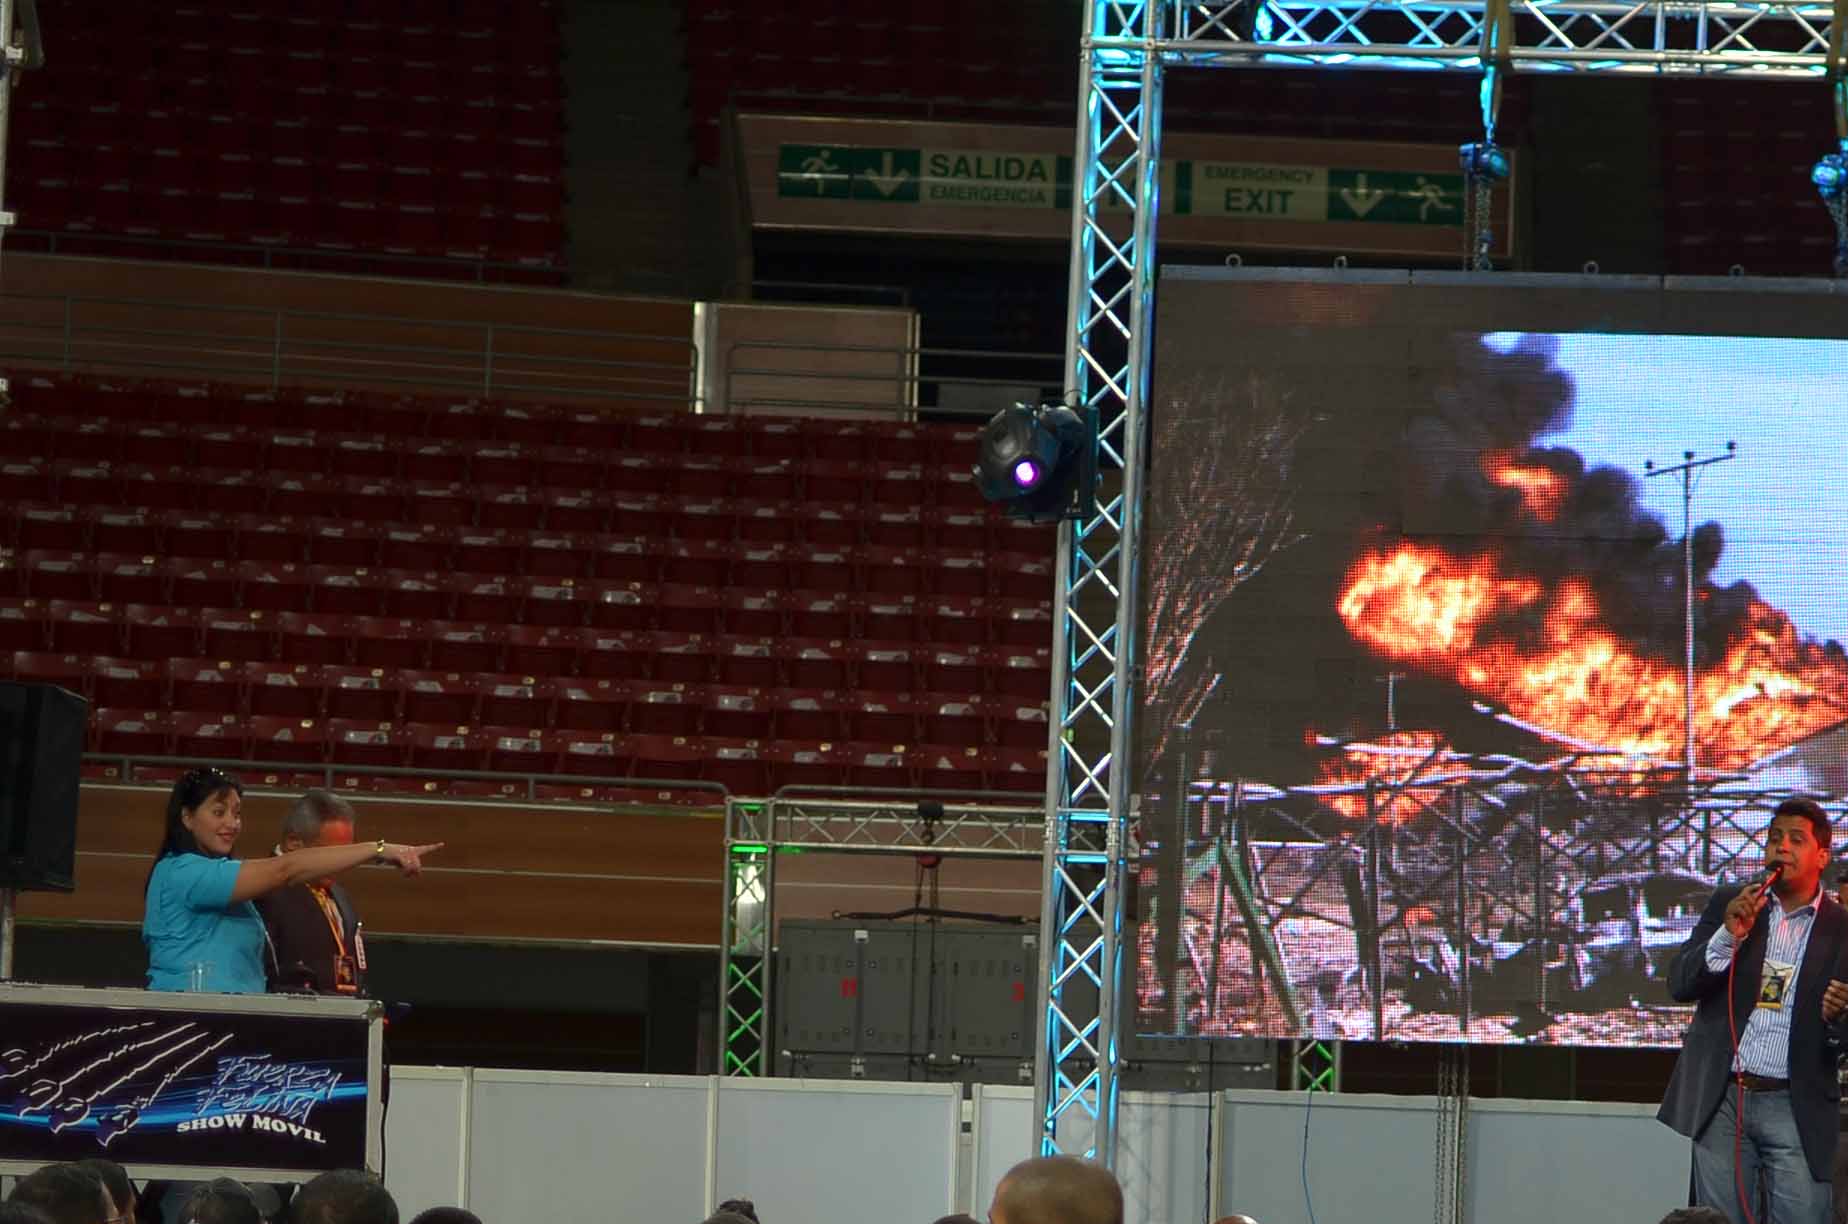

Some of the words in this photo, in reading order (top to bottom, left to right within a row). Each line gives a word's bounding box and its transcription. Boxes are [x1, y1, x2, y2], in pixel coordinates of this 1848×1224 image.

[929, 153, 1048, 182] SALIDA
[1204, 165, 1314, 183] EMERGENCY
[929, 184, 1048, 203] EMERGENCIA
[1224, 186, 1295, 214] EXIT
[176, 1113, 248, 1133] SHOW
[252, 1114, 327, 1144] MOVIL
